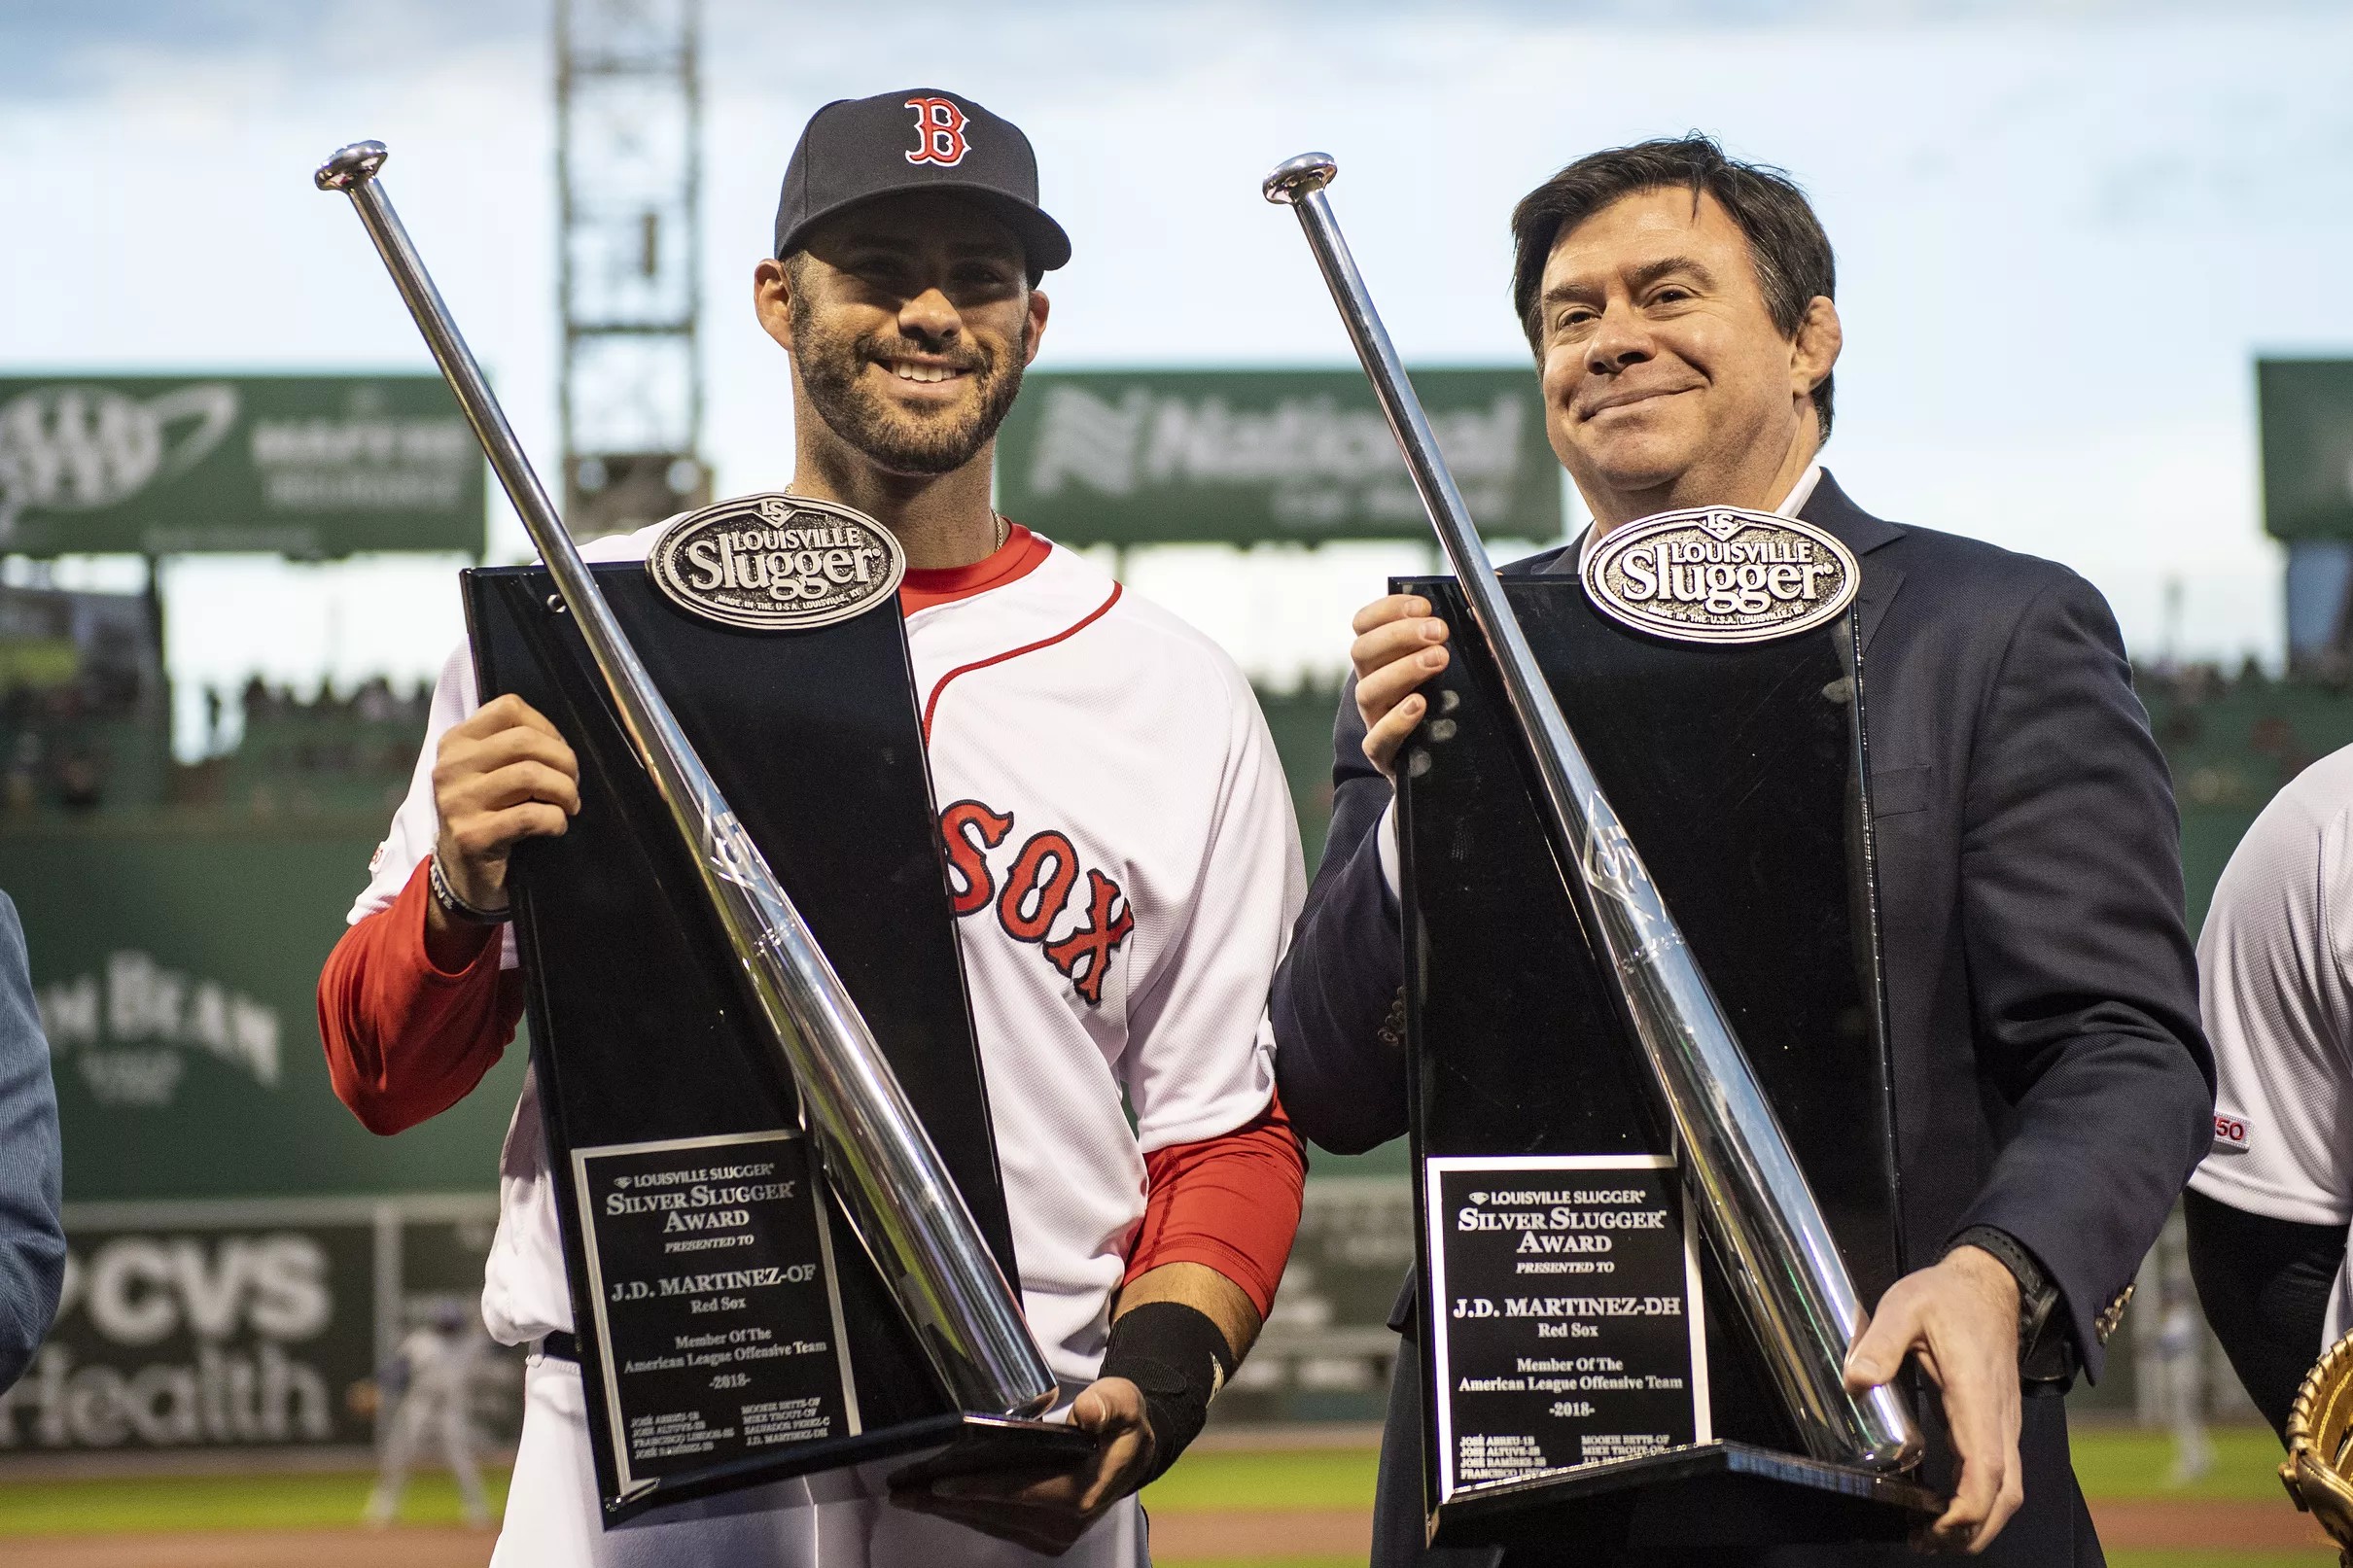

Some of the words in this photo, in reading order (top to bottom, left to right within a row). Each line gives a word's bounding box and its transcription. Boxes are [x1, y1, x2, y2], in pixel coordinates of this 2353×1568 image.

[904, 97, 971, 167] B
[732, 528, 861, 551] LOUISVILLE
[1671, 542, 1813, 564] LOUISVILLE
[687, 533, 873, 601] Slugger
[1621, 543, 1823, 614] Slugger
[717, 595, 742, 608] MADE
[744, 601, 754, 610] IN
[756, 602, 773, 610] THE
[1648, 605, 1673, 618] MADE
[1675, 612, 1687, 621] IN
[1688, 613, 1707, 623] THE
[939, 799, 1135, 1005] SOX
[634, 1167, 708, 1188] LOUISVILLE
[1491, 1191, 1571, 1205] LOUISVILLE
[663, 1209, 750, 1234] AWARD
[1458, 1207, 1548, 1231] SILVER
[664, 1237, 736, 1253] PRESENTED
[738, 1235, 755, 1246] TO
[1516, 1231, 1613, 1254] AWARD
[1516, 1262, 1595, 1274] PRESENTED
[1596, 1261, 1615, 1273] TO
[90, 1236, 331, 1345] CVS
[611, 1280, 656, 1303] J.D.
[658, 1264, 817, 1296] MARTINEZ-OF
[690, 1299, 720, 1313] Red
[720, 1296, 746, 1311] Sox
[1453, 1299, 1500, 1318] J.D.
[1504, 1297, 1681, 1317] MARTINEZ-DH
[675, 1334, 727, 1349] Member
[729, 1330, 750, 1344] Of
[750, 1327, 772, 1342] The
[1537, 1323, 1569, 1339] Red
[1570, 1322, 1599, 1338] Sox
[624, 1356, 685, 1374] American
[686, 1351, 732, 1367] League
[733, 1343, 793, 1361] Offensive
[792, 1341, 827, 1354] Team
[1517, 1358, 1573, 1373] Member
[1576, 1358, 1597, 1372] Of
[1597, 1357, 1624, 1372] The
[709, 1373, 752, 1390] -2018-
[1458, 1376, 1525, 1391] American
[1527, 1376, 1578, 1393] League
[1579, 1376, 1644, 1390] Offensive
[1645, 1376, 1683, 1389] Team
[1549, 1402, 1596, 1417] -2018-
